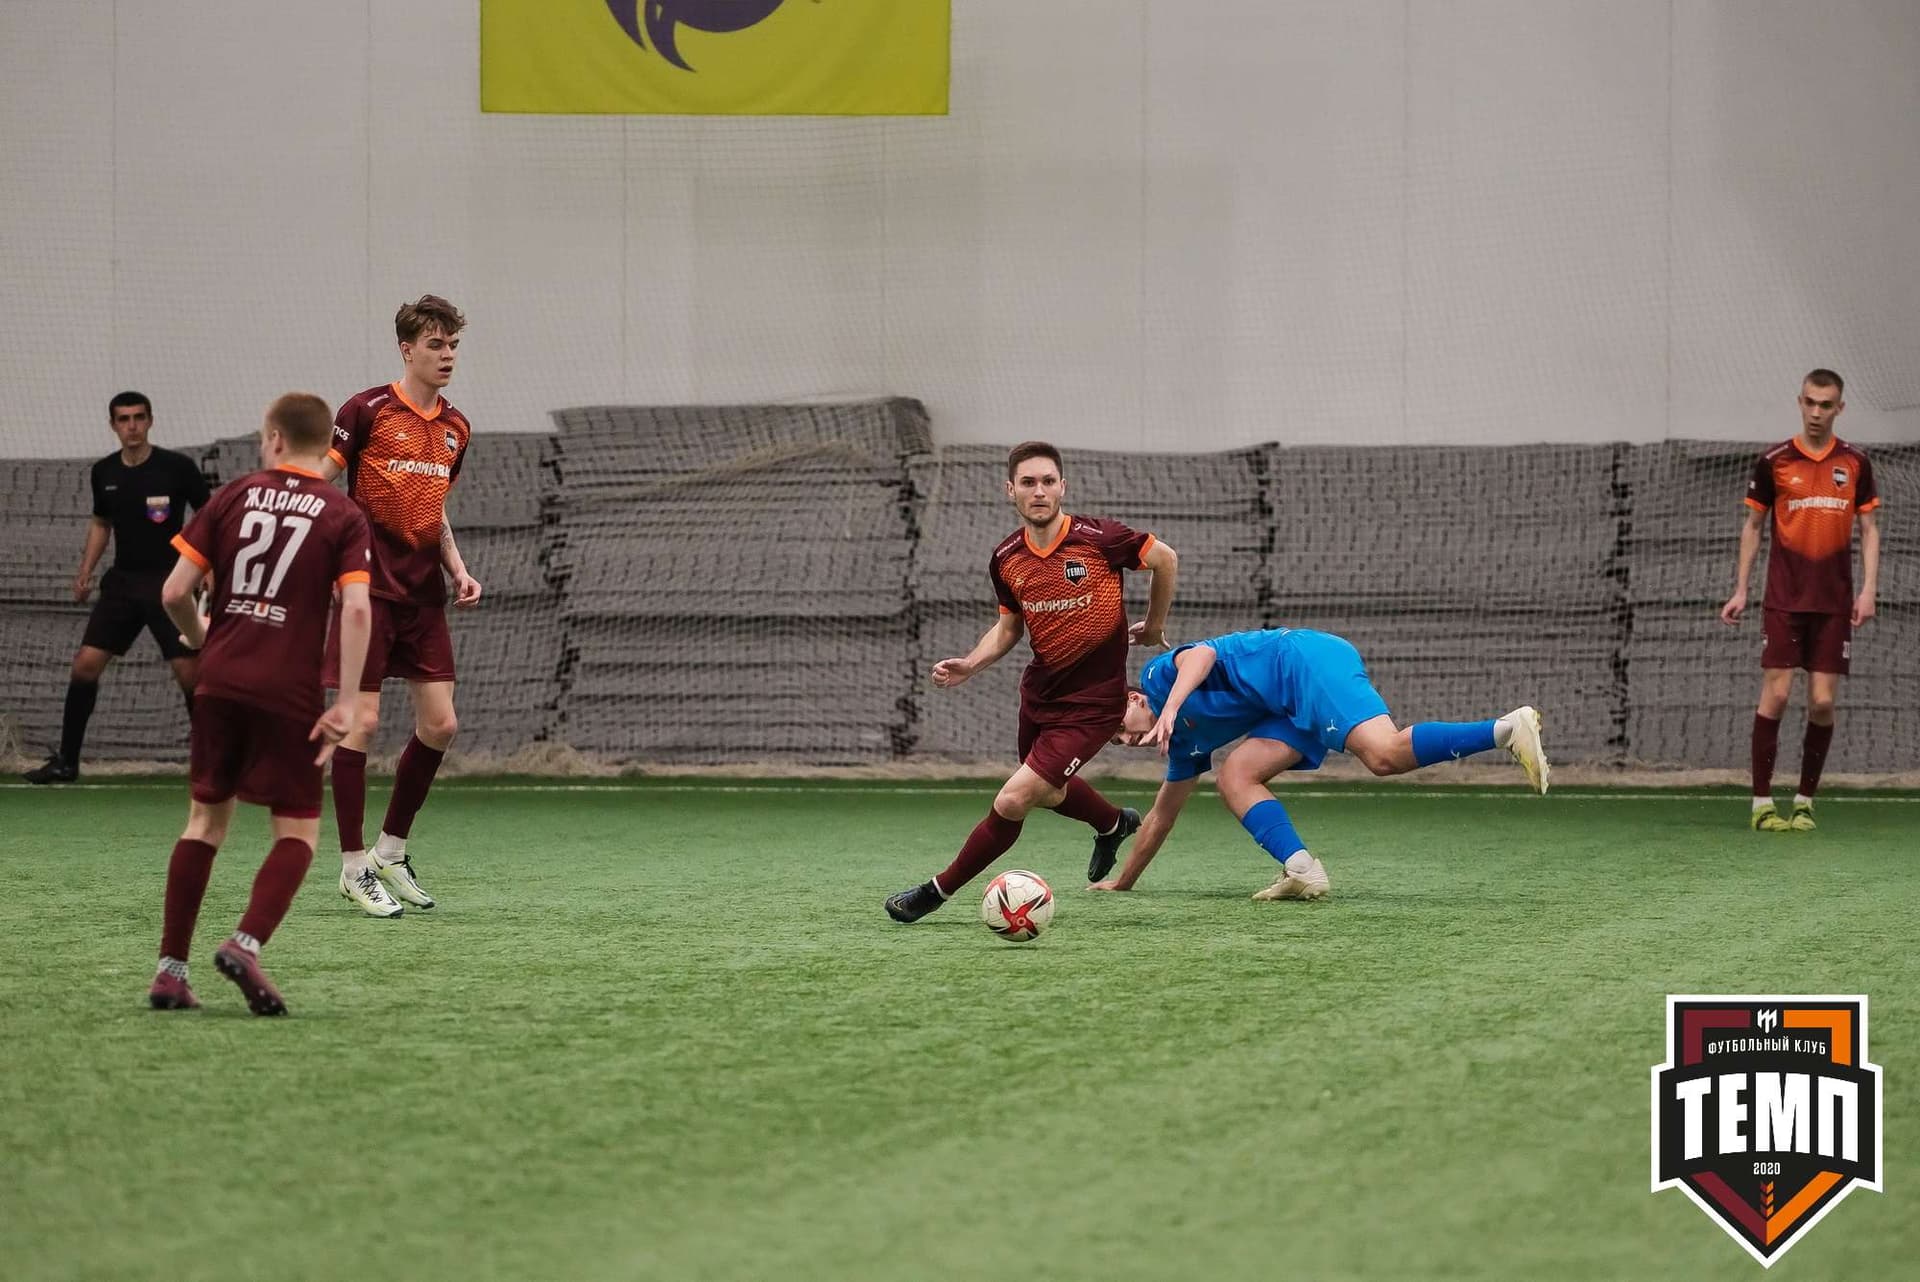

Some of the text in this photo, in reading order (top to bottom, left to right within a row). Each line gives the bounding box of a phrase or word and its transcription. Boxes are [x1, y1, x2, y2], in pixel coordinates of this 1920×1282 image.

[244, 486, 326, 517] ЖДАНОВ
[232, 510, 312, 598] 27
[1064, 757, 1081, 776] 5
